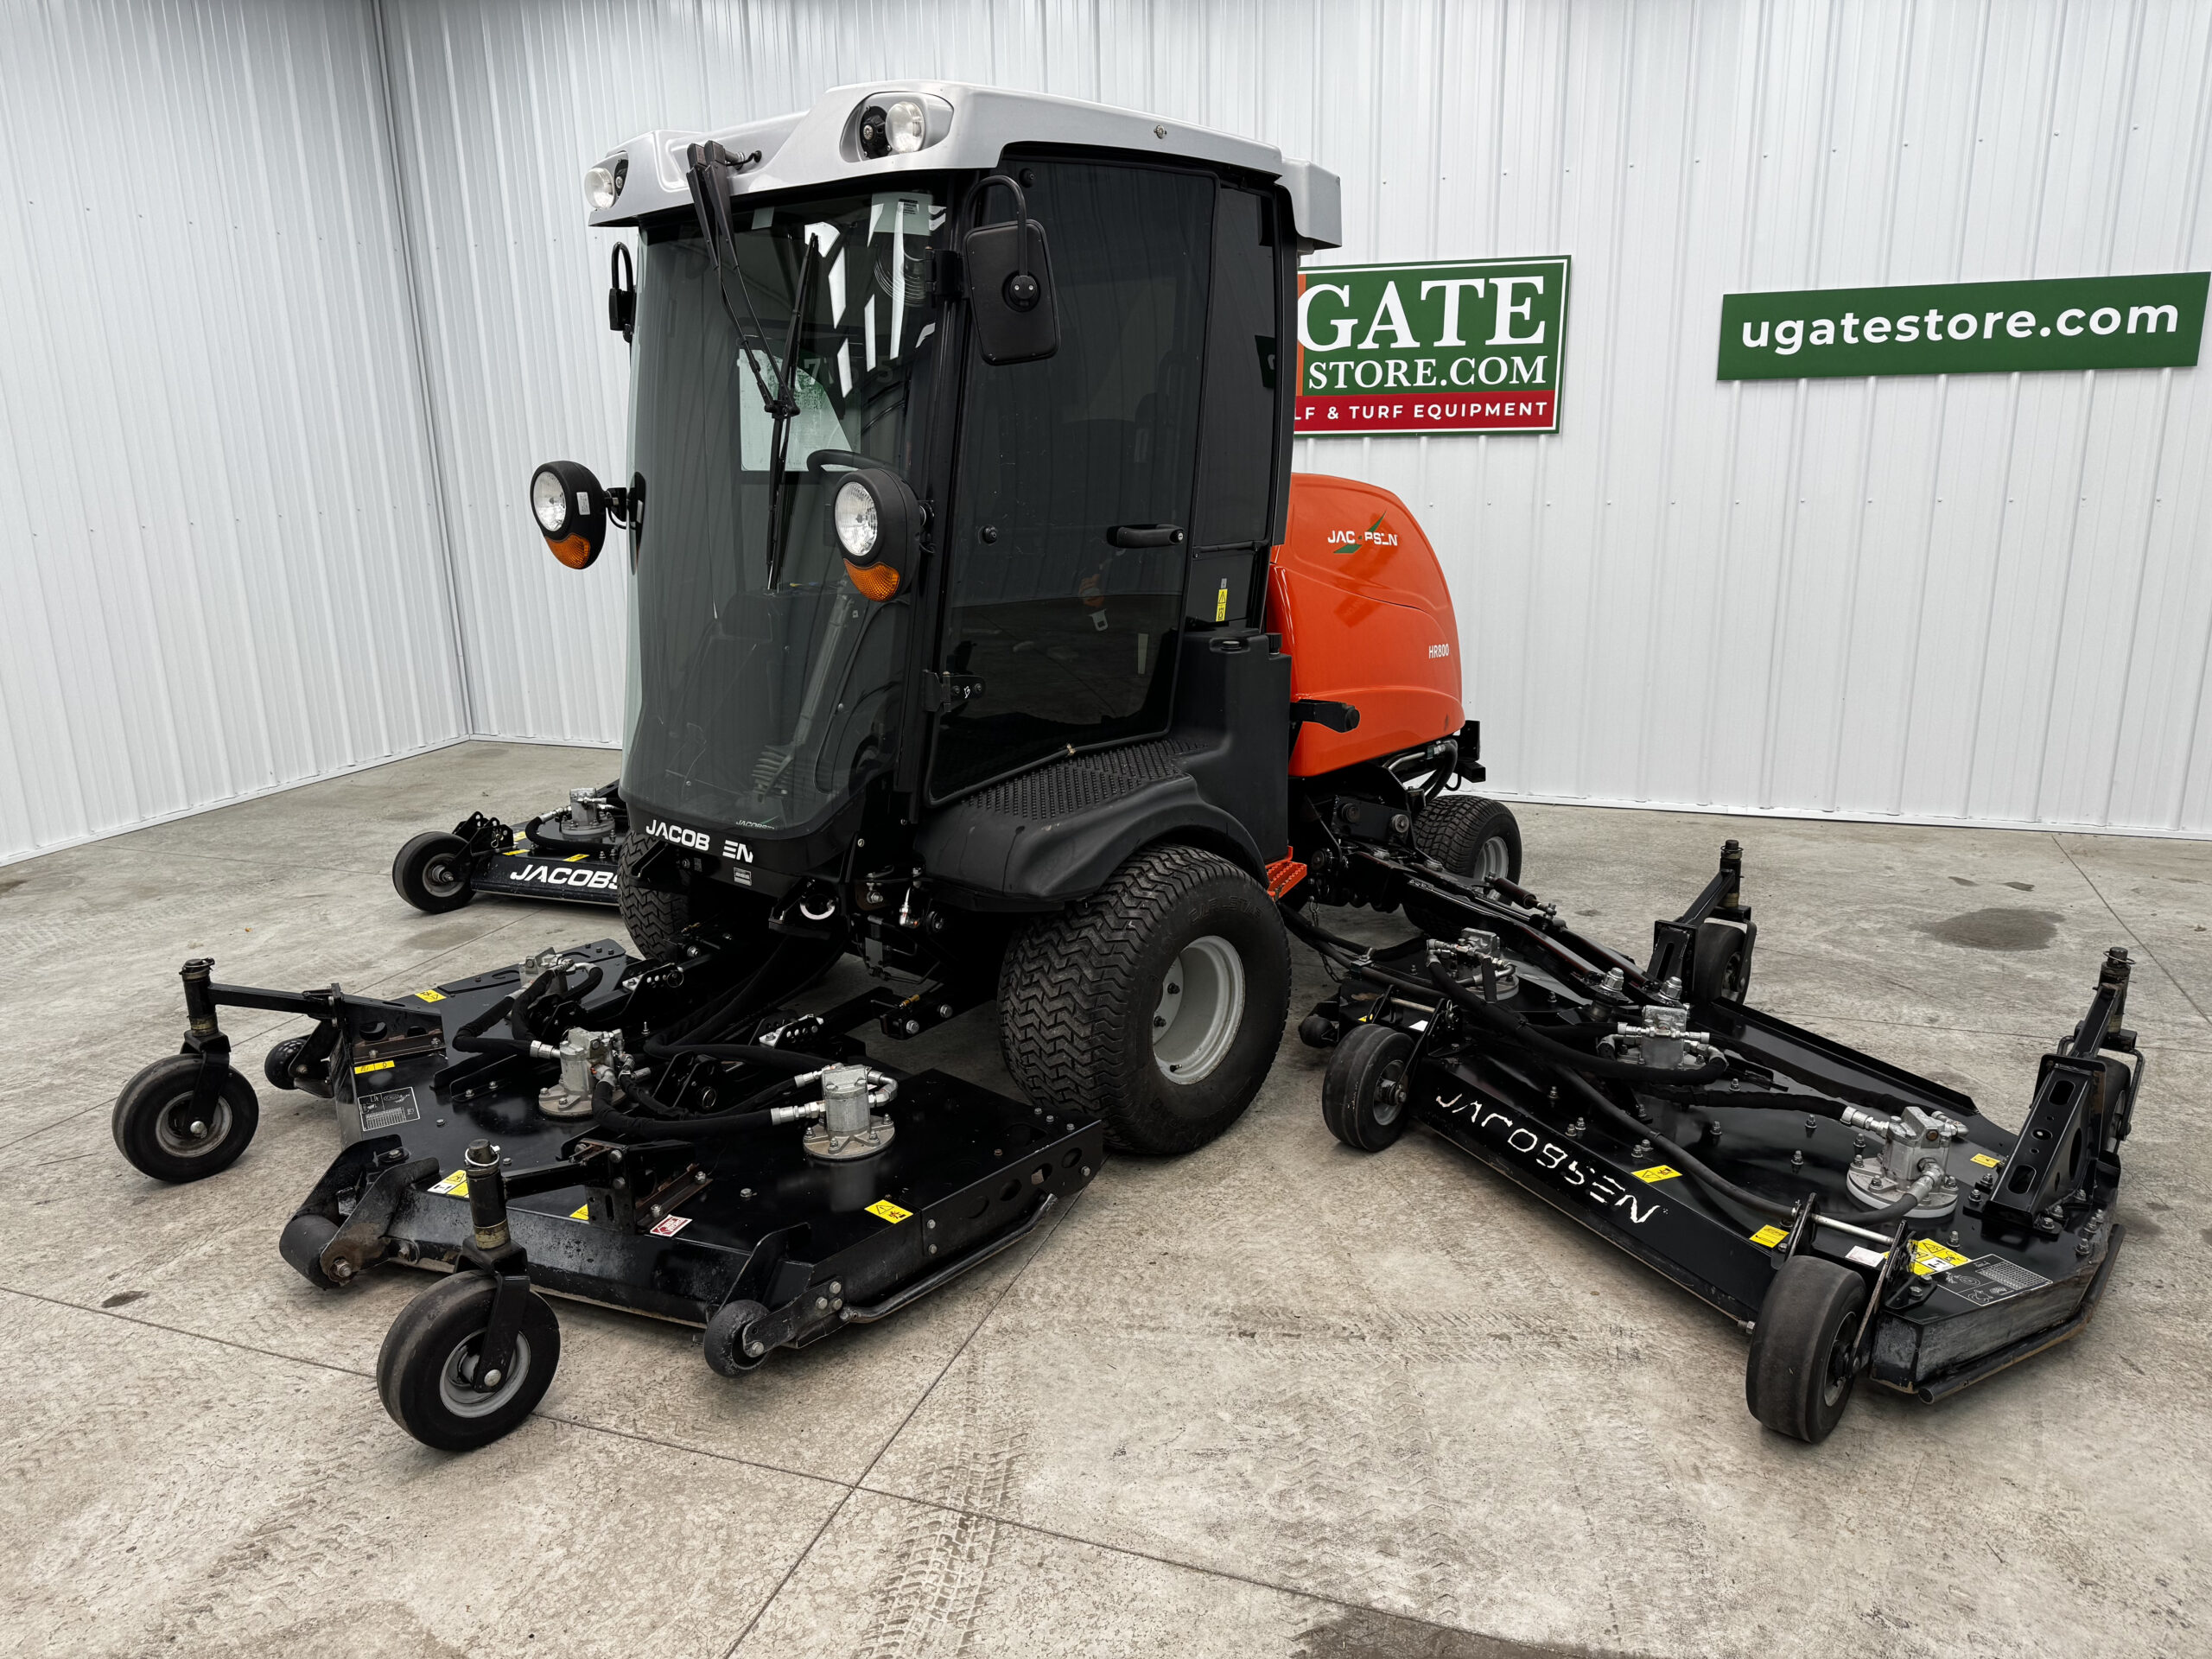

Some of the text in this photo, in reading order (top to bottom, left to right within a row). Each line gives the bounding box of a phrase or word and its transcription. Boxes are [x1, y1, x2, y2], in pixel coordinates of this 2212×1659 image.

[1742, 302, 2178, 355] ugatestore.com
[1308, 355, 1548, 389] STORE.COM
[1327, 406, 1338, 419] &
[1349, 404, 1404, 419] TURF
[1414, 402, 1548, 420] EQUIPMENT
[1428, 644, 1449, 659] HR800
[646, 820, 753, 863] JACOBEN
